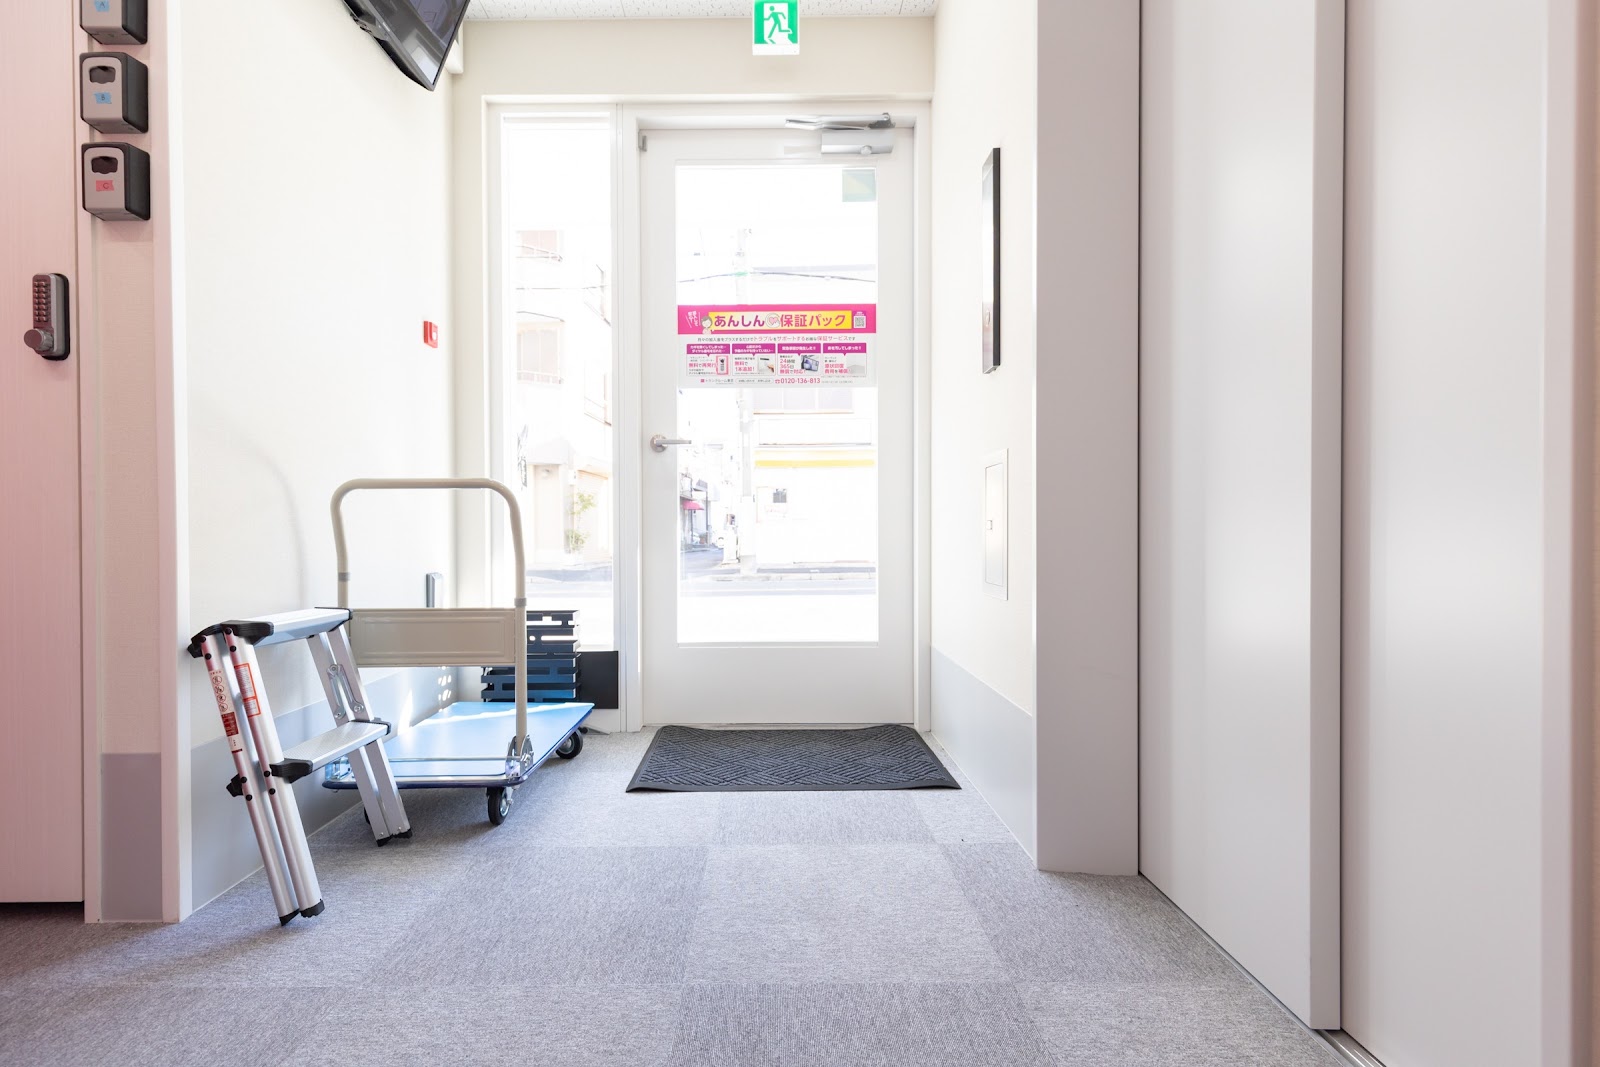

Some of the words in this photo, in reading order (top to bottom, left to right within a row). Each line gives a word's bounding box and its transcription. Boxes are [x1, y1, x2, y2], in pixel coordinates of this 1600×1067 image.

[714, 315, 765, 327] あんしん
[780, 314, 846, 327] 保証パック
